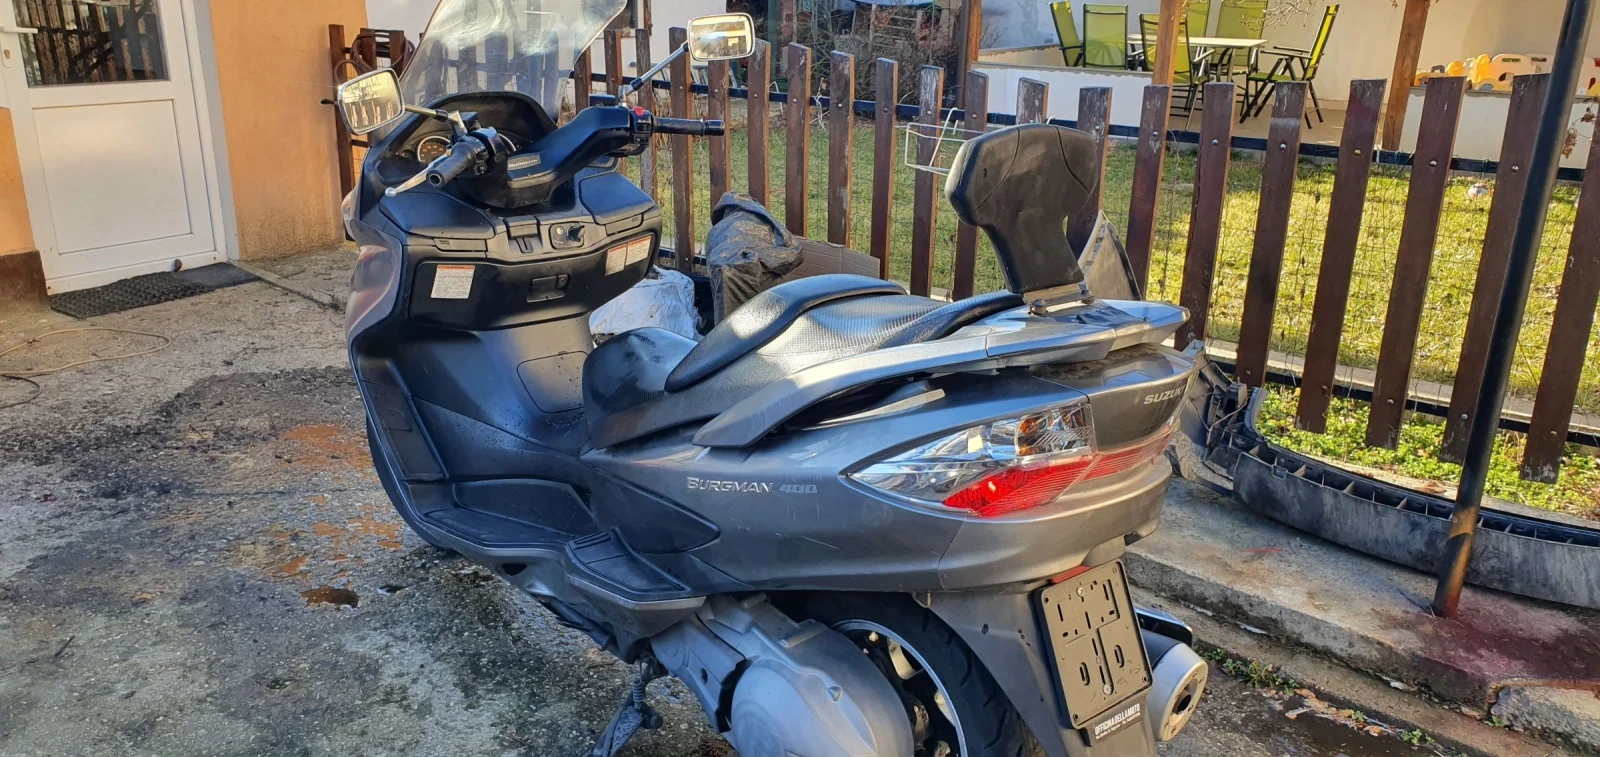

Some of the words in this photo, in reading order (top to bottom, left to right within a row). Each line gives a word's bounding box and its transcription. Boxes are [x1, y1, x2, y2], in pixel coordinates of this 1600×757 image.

[1143, 384, 1186, 405] SUZUKI
[686, 476, 774, 494] BURGMAN
[779, 484, 818, 494] 400
